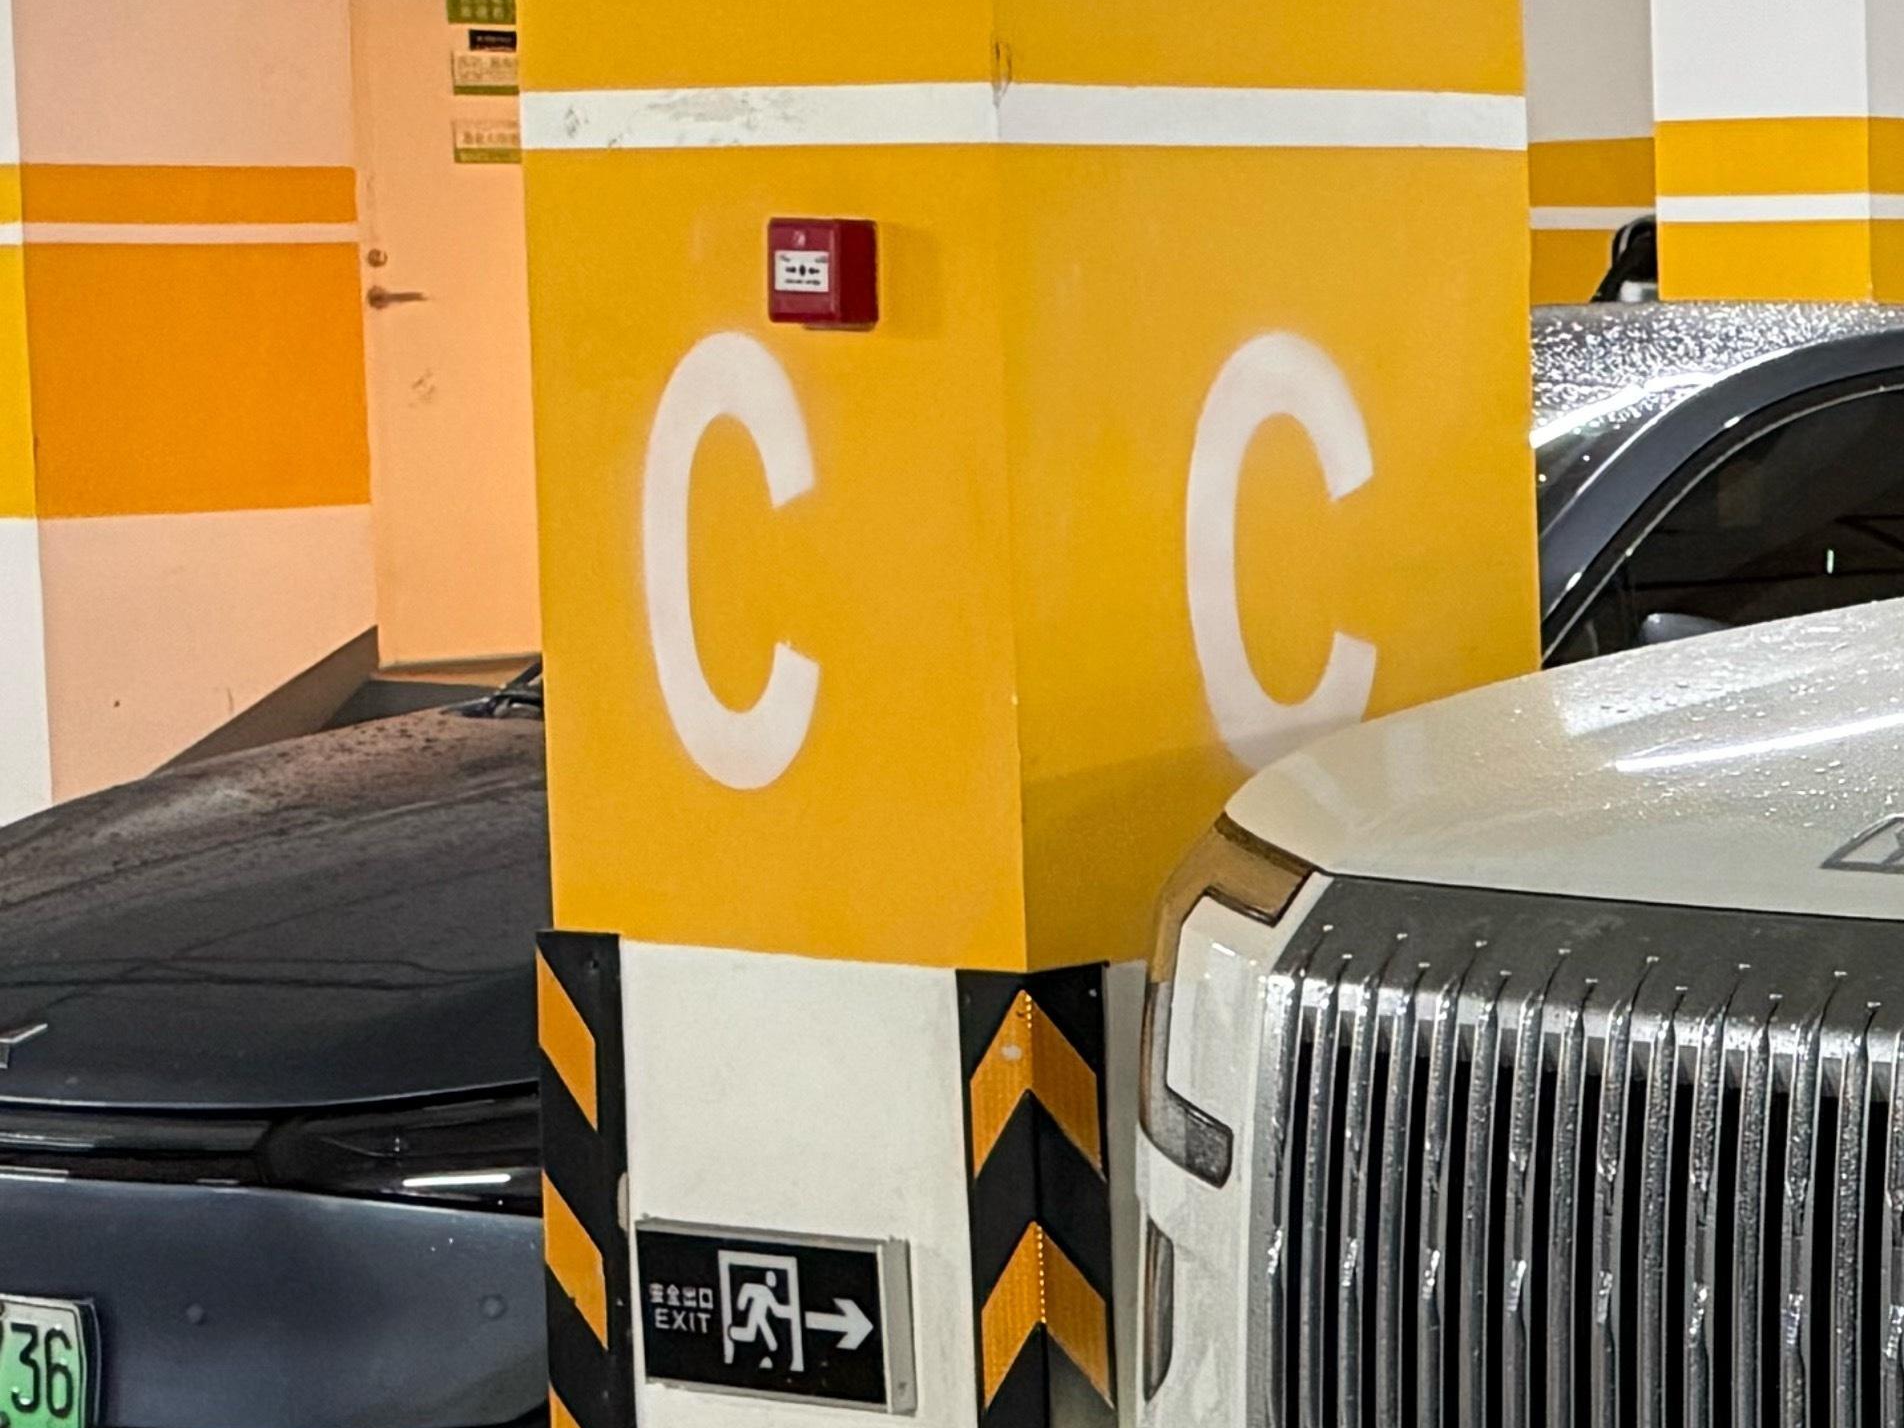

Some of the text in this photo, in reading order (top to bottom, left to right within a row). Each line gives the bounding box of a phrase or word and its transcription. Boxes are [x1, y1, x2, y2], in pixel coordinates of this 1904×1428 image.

[642, 330, 821, 791] C
[1185, 331, 1378, 774] C
[0, 1321, 74, 1420] 36
[654, 1307, 712, 1334] EXIT
